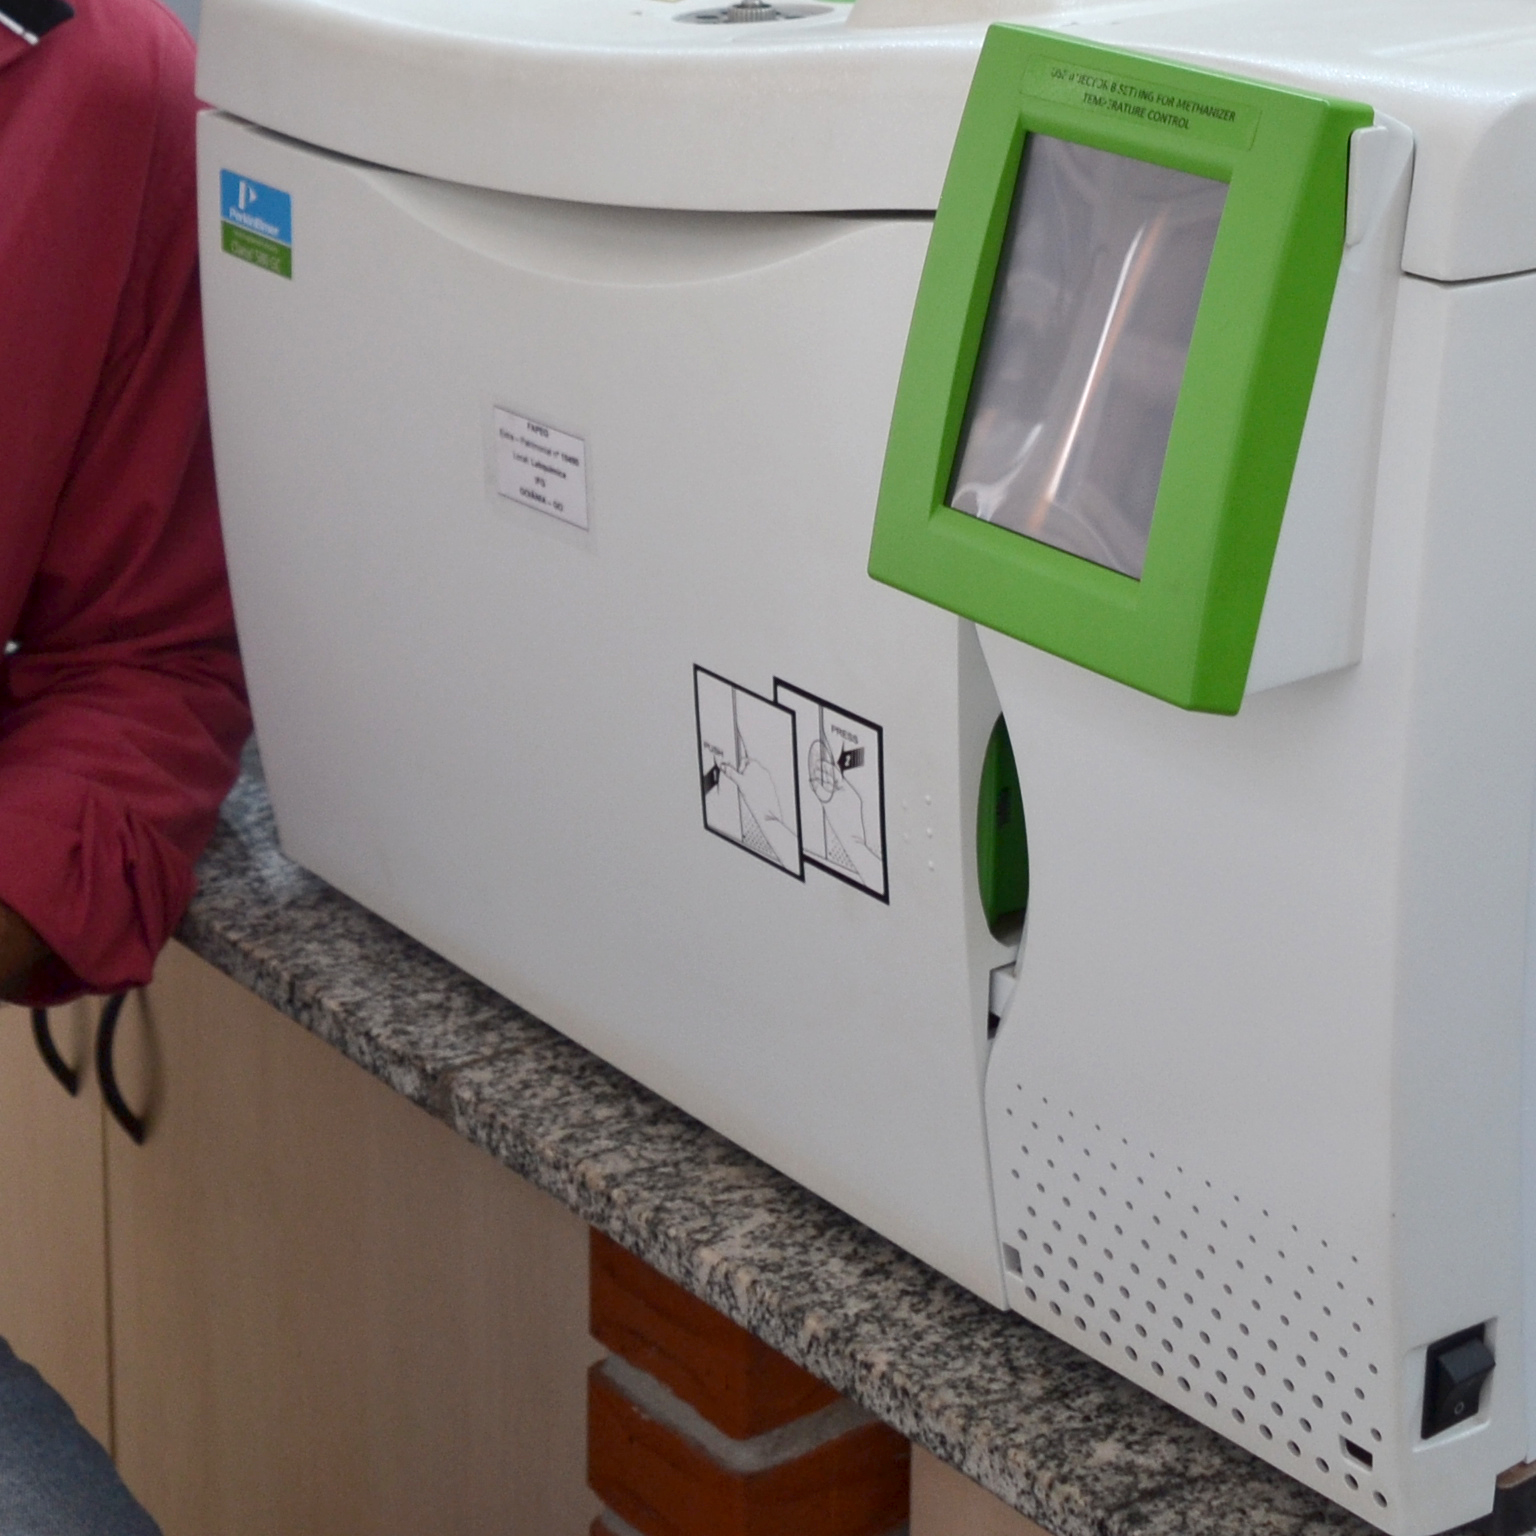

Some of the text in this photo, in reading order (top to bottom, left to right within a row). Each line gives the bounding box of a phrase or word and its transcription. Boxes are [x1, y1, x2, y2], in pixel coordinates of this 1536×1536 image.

[1147, 106, 1191, 130] CONTROL
[1156, 93, 1175, 107] FOR
[1176, 96, 1237, 123] METHANIZER
[830, 723, 859, 745] PRESS
